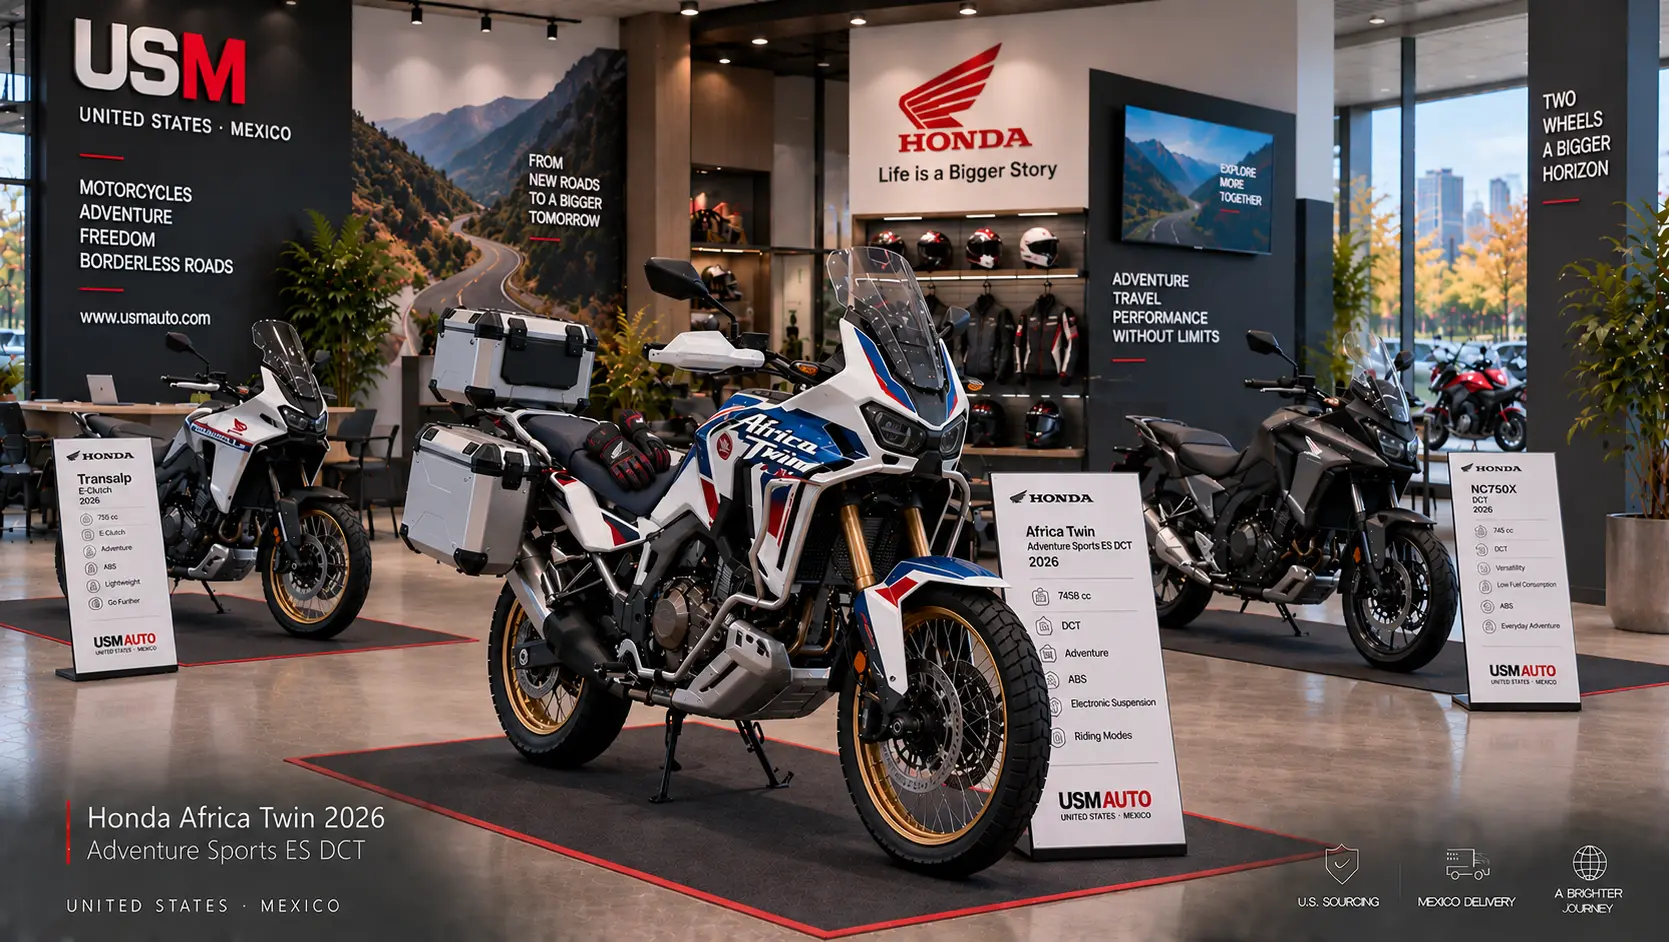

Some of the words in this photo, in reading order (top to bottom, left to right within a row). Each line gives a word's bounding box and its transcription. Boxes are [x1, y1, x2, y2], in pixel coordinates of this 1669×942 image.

[74, 18, 246, 104] USM
[1543, 90, 1576, 109] TWO
[80, 107, 144, 127] UNITED
[151, 114, 212, 134] STATES
[231, 121, 291, 141] MEXICO
[1543, 110, 1603, 133] WHEELS
[899, 128, 1032, 152] HONDA
[1543, 142, 1552, 158] A
[1557, 135, 1611, 156] BIGGER
[529, 154, 563, 170] FROM
[879, 166, 909, 182] Life
[916, 166, 928, 181] is
[934, 168, 943, 180] a
[950, 164, 1005, 183] Bigger
[1010, 161, 1057, 180] Story
[1220, 163, 1256, 178] EXPLORE
[1543, 160, 1608, 182] HORIZON
[529, 173, 557, 187] NEW
[560, 176, 600, 191] ROADS
[1220, 177, 1244, 190] MORE
[80, 180, 192, 202] MOTORCYCLES
[1220, 191, 1262, 206] TOGETHER
[529, 192, 545, 205] TO
[548, 193, 557, 206] A
[560, 194, 602, 209] BIGGER
[80, 204, 172, 224] ADVENTURE
[529, 211, 600, 227] TOMORROW
[80, 228, 155, 248] FREEDOM
[80, 253, 180, 272] BORDERLESS
[185, 258, 233, 274] ROADS
[1112, 272, 1189, 287] ADVENTURE
[1113, 292, 1162, 305] TRAVEL
[80, 310, 210, 326] www.usmauto.com
[1113, 310, 1208, 324] PERFORMANCE
[1113, 329, 1174, 343] WITHOUT
[1178, 330, 1220, 343] LIMITS
[728, 413, 818, 455] Africa
[82, 452, 134, 460] HONDA
[77, 473, 132, 485] Transalp
[1471, 484, 1517, 494] NC750X
[80, 497, 100, 505] 2026
[1030, 494, 1094, 502] HONDA
[1472, 496, 1487, 504] DCT
[1026, 526, 1064, 537] Africa
[1066, 526, 1095, 537] Twin
[1027, 542, 1070, 551] Adventure
[1072, 542, 1100, 551] Sports
[1102, 541, 1112, 549] ES
[1114, 541, 1132, 549] DCT
[1029, 556, 1059, 567] 2026
[105, 579, 141, 588] Lightweight
[1062, 621, 1081, 630] DCT
[1065, 649, 1109, 658] Adventure
[1068, 675, 1087, 683] ABS
[1071, 699, 1110, 708] Electronic
[1112, 699, 1156, 709] Suspension
[1075, 732, 1101, 742] Riding
[1103, 731, 1132, 740] Modes
[1061, 813, 1088, 821] UNITED
[1090, 812, 1115, 820] STATES
